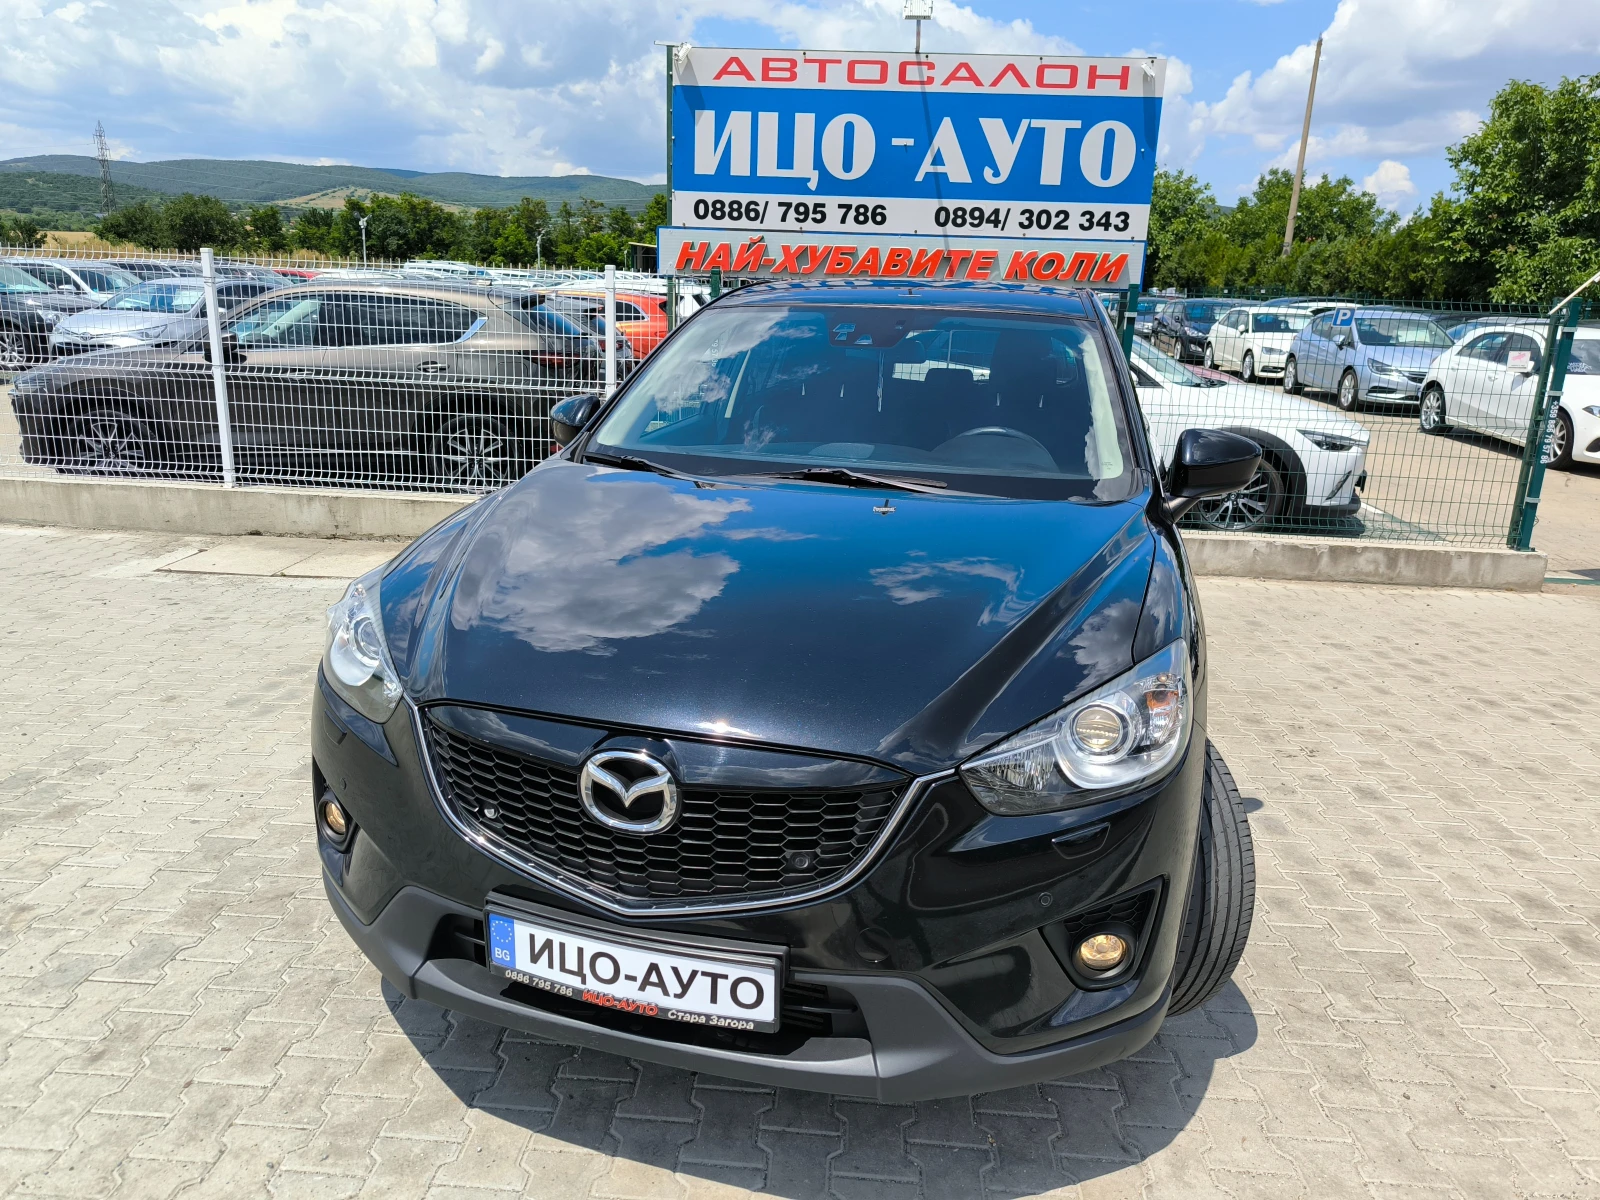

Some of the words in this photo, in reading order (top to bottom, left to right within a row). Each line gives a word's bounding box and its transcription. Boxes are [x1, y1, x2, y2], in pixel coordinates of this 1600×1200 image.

[712, 56, 1131, 91] АВТОСАЛОН
[693, 198, 769, 224] 0886/
[777, 201, 827, 224] 795
[837, 203, 887, 226] 786
[934, 206, 1012, 231] 0894/
[1018, 208, 1070, 231] 302
[1078, 210, 1131, 233] 343
[674, 234, 1000, 281] НАЙ-ХУБАВИТЕ
[1003, 248, 1130, 284] КОЛИ
[1336, 309, 1351, 325] P
[1549, 400, 1559, 418] +359
[494, 947, 510, 961] BG
[528, 932, 765, 1010] ИЦО-АУТО
[505, 969, 530, 984] 0886
[532, 977, 551, 990] 795
[554, 984, 573, 997] 786
[582, 990, 659, 1016] ИЦО-АУТО
[667, 1009, 706, 1024] Стара
[709, 1017, 754, 1030] Загора
